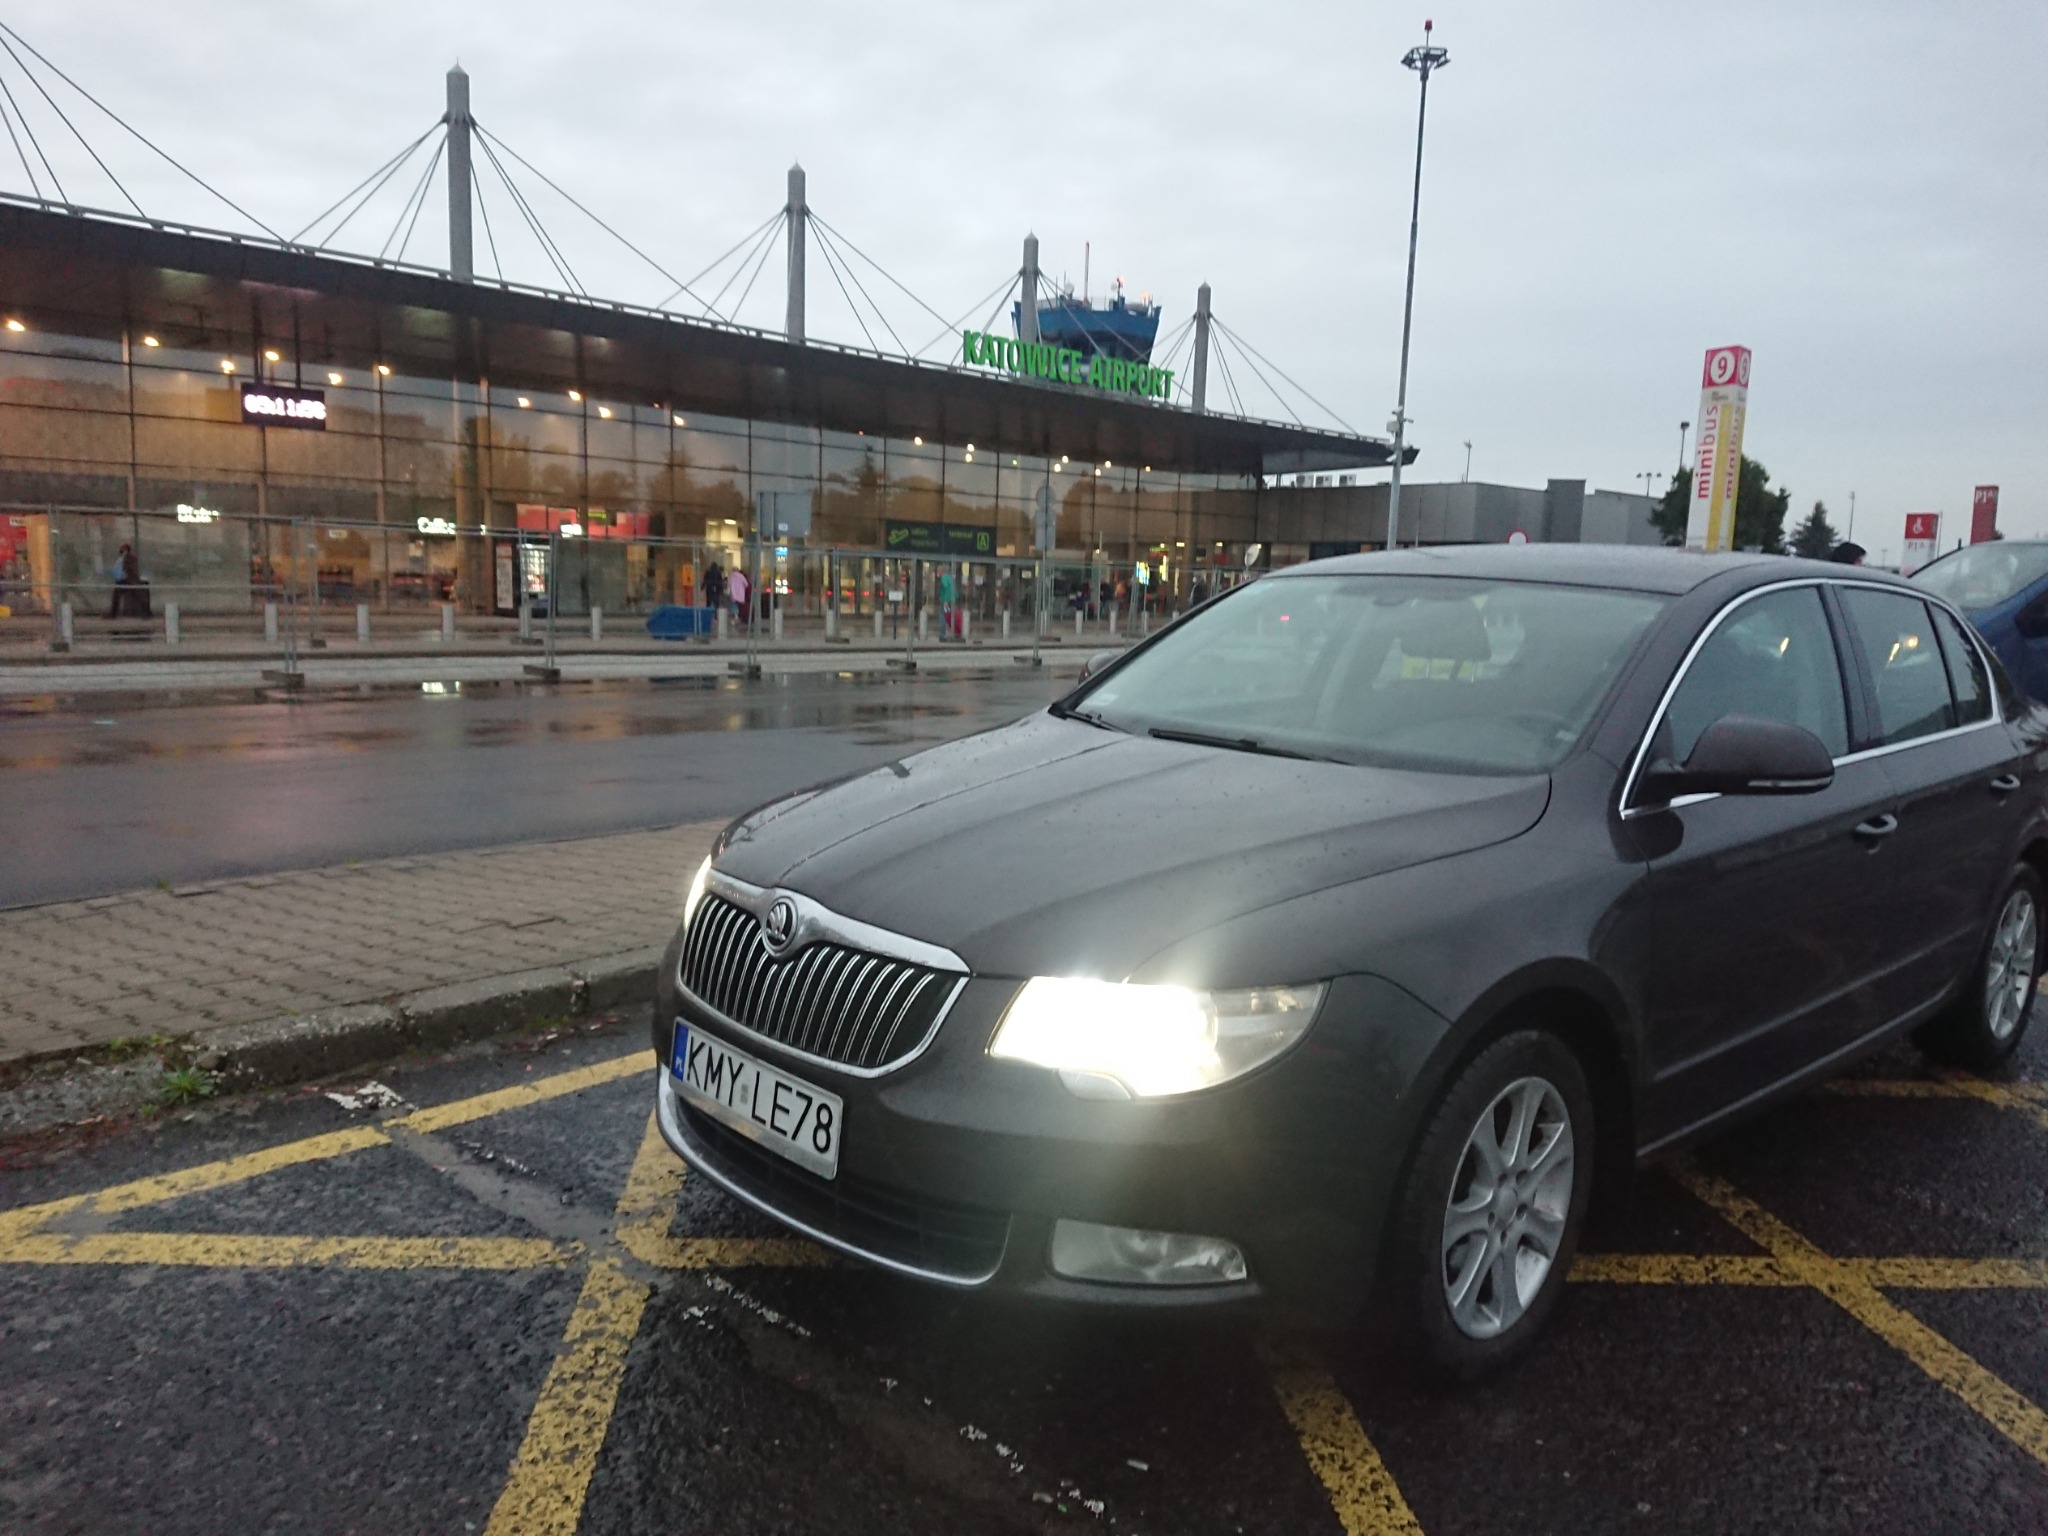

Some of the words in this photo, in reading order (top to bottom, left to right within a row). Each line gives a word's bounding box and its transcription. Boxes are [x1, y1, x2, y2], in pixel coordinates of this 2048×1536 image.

[962, 329, 1083, 384] KATOWICE
[1088, 354, 1175, 399] AIRPORT
[1717, 356, 1728, 379] 9
[1697, 404, 1719, 499] minibus
[674, 1056, 684, 1072] PL
[687, 1036, 745, 1107] KMY
[751, 1070, 833, 1153] LE78
